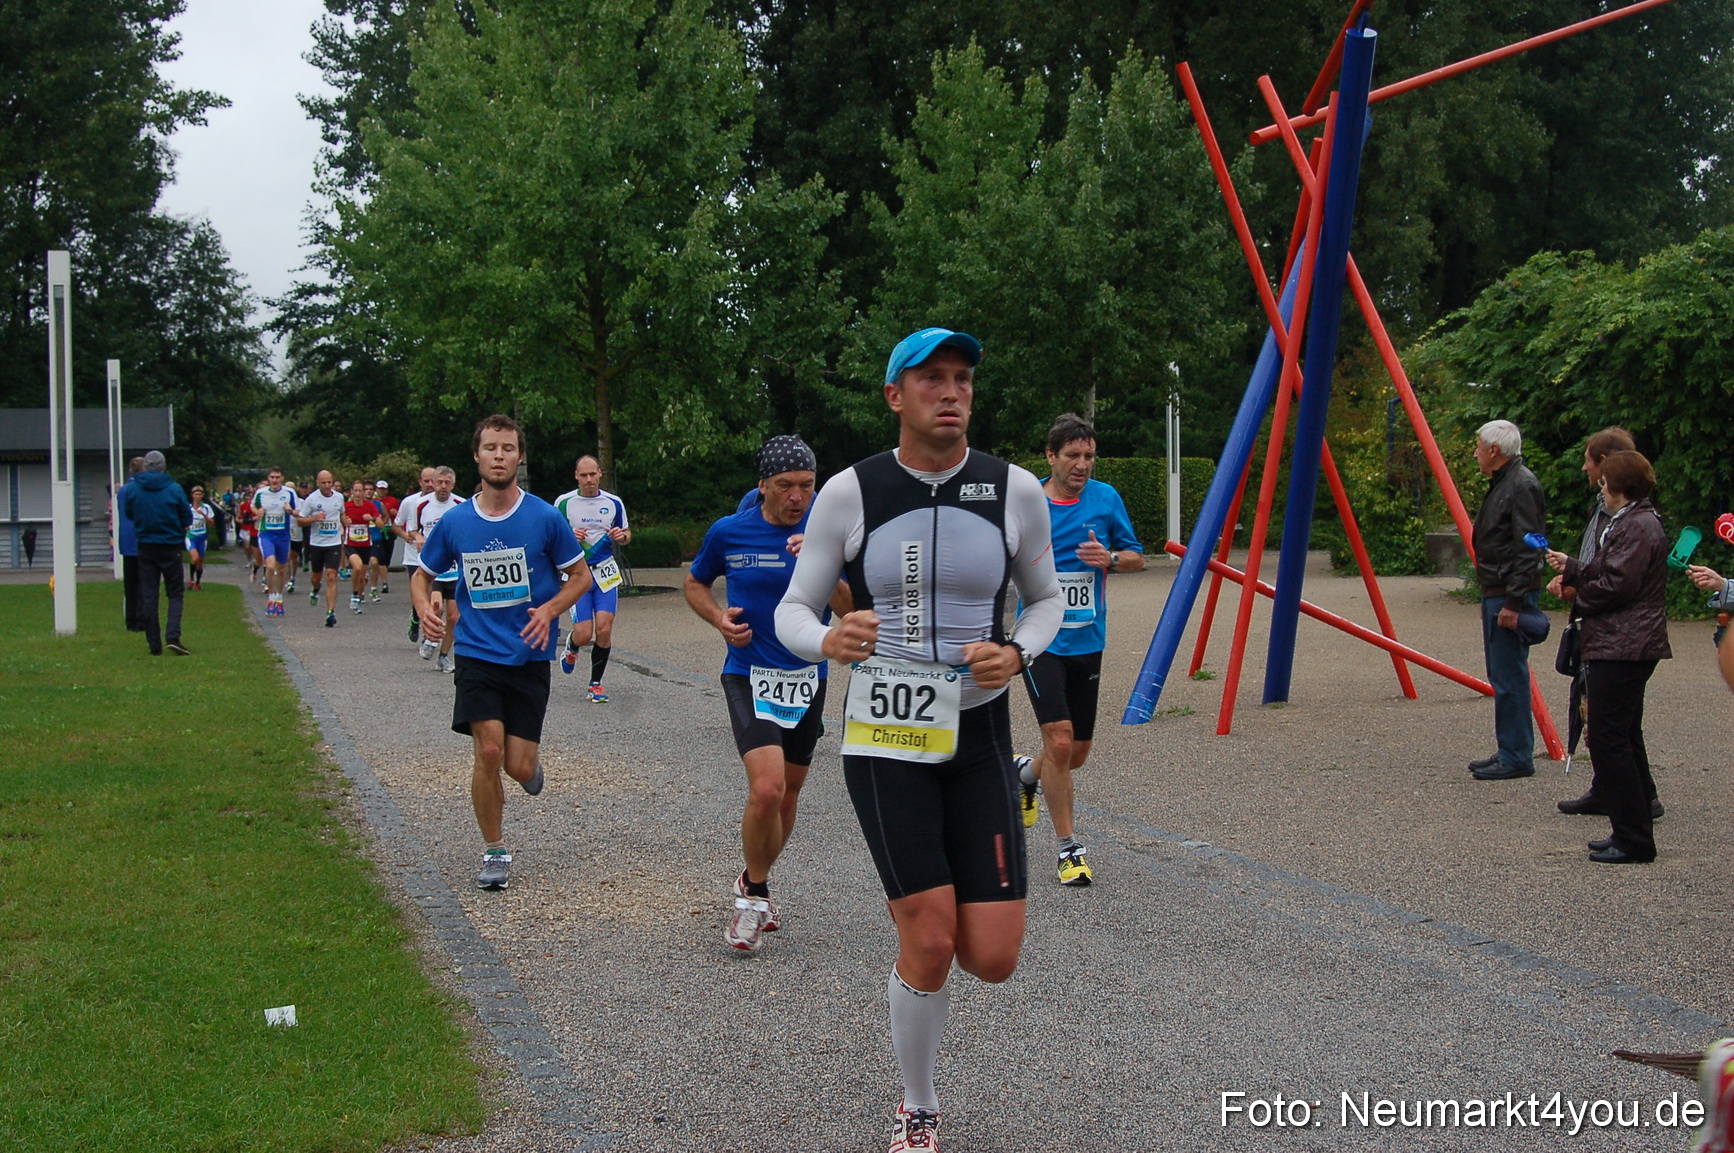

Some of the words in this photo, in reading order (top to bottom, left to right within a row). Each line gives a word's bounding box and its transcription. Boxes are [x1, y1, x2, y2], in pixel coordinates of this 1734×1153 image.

[484, 554, 514, 563] Neumarkt
[905, 544, 919, 584] Roth
[469, 562, 523, 588] 2430
[600, 563, 617, 579] 428
[482, 590, 515, 600] Gerhard
[906, 589, 920, 609] 08
[906, 614, 920, 645] TSG
[752, 668, 775, 677] PARTL
[776, 671, 807, 679] Neumarkt
[855, 665, 886, 676] PARTL
[888, 668, 942, 680] Neumarkt
[758, 679, 814, 704] 2479
[870, 682, 937, 722] 502
[872, 728, 928, 748] Christof
